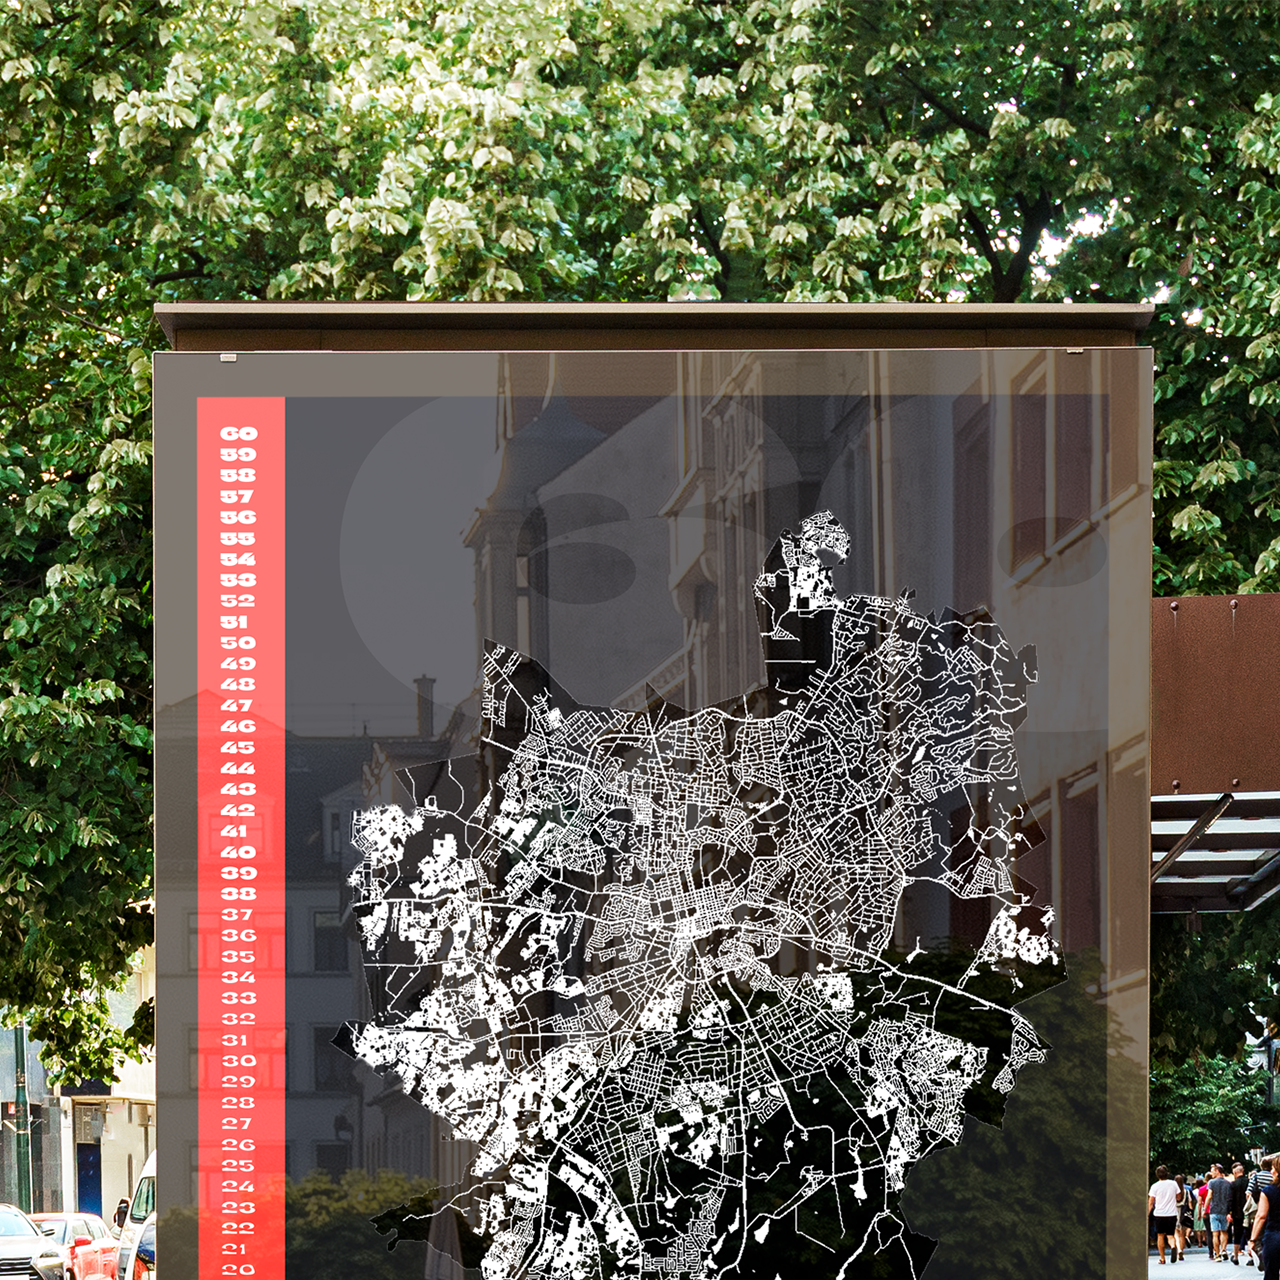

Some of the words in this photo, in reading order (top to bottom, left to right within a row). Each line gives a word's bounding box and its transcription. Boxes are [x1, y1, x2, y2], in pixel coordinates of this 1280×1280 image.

[219, 426, 259, 441] 60
[220, 447, 257, 462] 59
[220, 467, 257, 483] 58
[220, 489, 254, 504] 57
[220, 509, 257, 525] 56
[220, 531, 256, 546] 55
[220, 552, 257, 567] 54
[220, 572, 257, 588] 53
[220, 593, 256, 608] 52
[220, 615, 248, 630] 51
[220, 635, 257, 650] 50
[220, 656, 257, 671] 49
[220, 677, 256, 692] 48
[220, 699, 253, 712] 47
[220, 719, 257, 734] 46
[220, 740, 256, 755] 45
[220, 761, 256, 775] 44
[220, 782, 257, 796] 43
[220, 803, 256, 817] 42
[220, 824, 247, 838] 41
[220, 845, 257, 860] 40
[220, 866, 258, 881] 39
[220, 886, 257, 901] 38
[221, 907, 253, 921] 37
[221, 928, 258, 942] 36
[221, 949, 256, 964] 35
[221, 970, 256, 984] 34
[221, 991, 257, 1005] 33
[221, 1012, 256, 1026] 32
[221, 1034, 247, 1047] 31
[222, 1054, 257, 1068] 30
[221, 1075, 256, 1089] 29
[221, 1096, 256, 1109] 28
[221, 1117, 252, 1130] 27
[221, 1138, 256, 1152] 26
[221, 1159, 255, 1173] 25
[221, 1179, 255, 1193] 24
[221, 1201, 256, 1214] 23
[221, 1221, 255, 1235] 22
[221, 1243, 246, 1255] 21
[221, 1263, 256, 1276] 20
